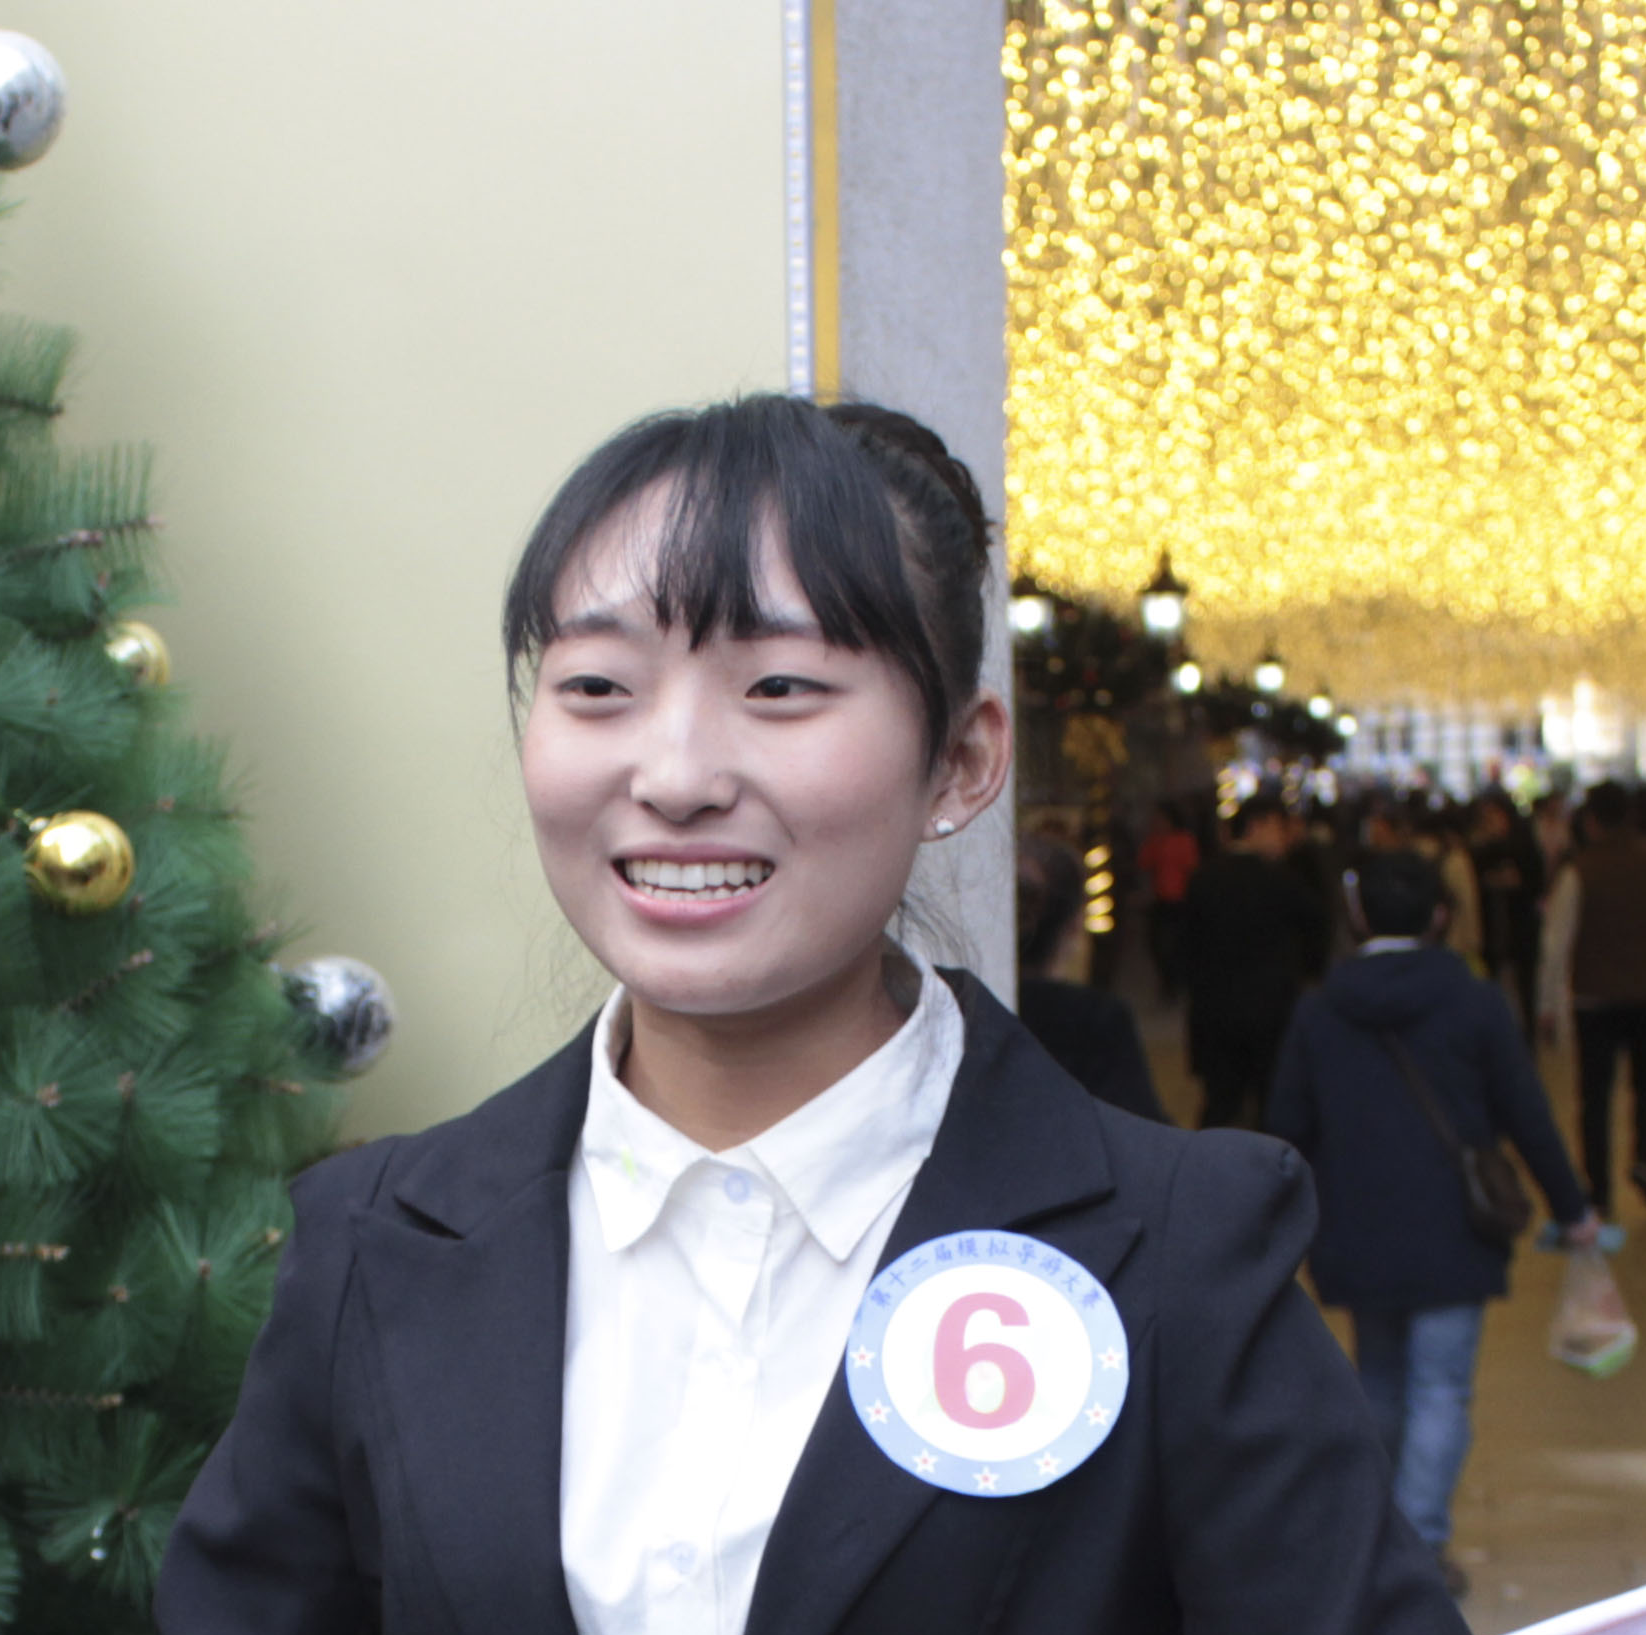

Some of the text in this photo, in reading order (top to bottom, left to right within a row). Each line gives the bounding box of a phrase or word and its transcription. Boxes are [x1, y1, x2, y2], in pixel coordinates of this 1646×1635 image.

[870, 1238, 1101, 1308] 第十二届模拟导游大赛
[933, 1292, 1036, 1430] 6
